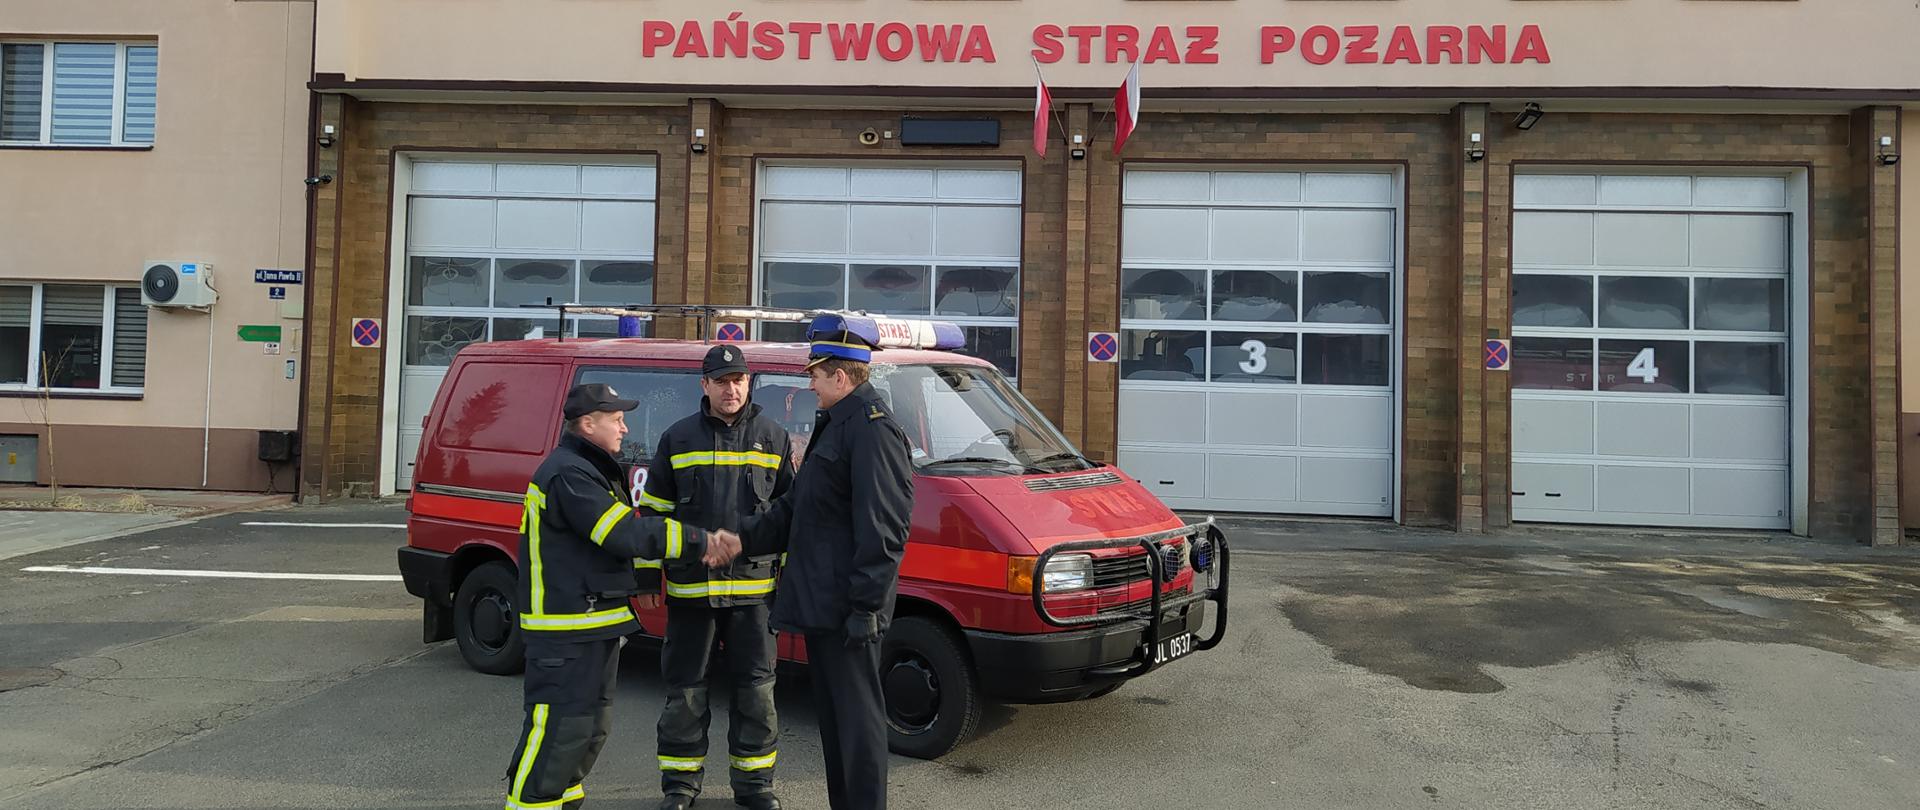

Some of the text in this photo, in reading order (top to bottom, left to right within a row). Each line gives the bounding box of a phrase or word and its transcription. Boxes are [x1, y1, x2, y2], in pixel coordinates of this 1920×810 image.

[642, 11, 1551, 65] PAŃSTWOWA STRAŻ POŻARNA
[263, 270, 277, 281] Jana
[877, 323, 910, 339] STRAŻ
[1239, 340, 1267, 374] 3
[1626, 347, 1659, 384] 4
[1170, 633, 1191, 658] 0537
